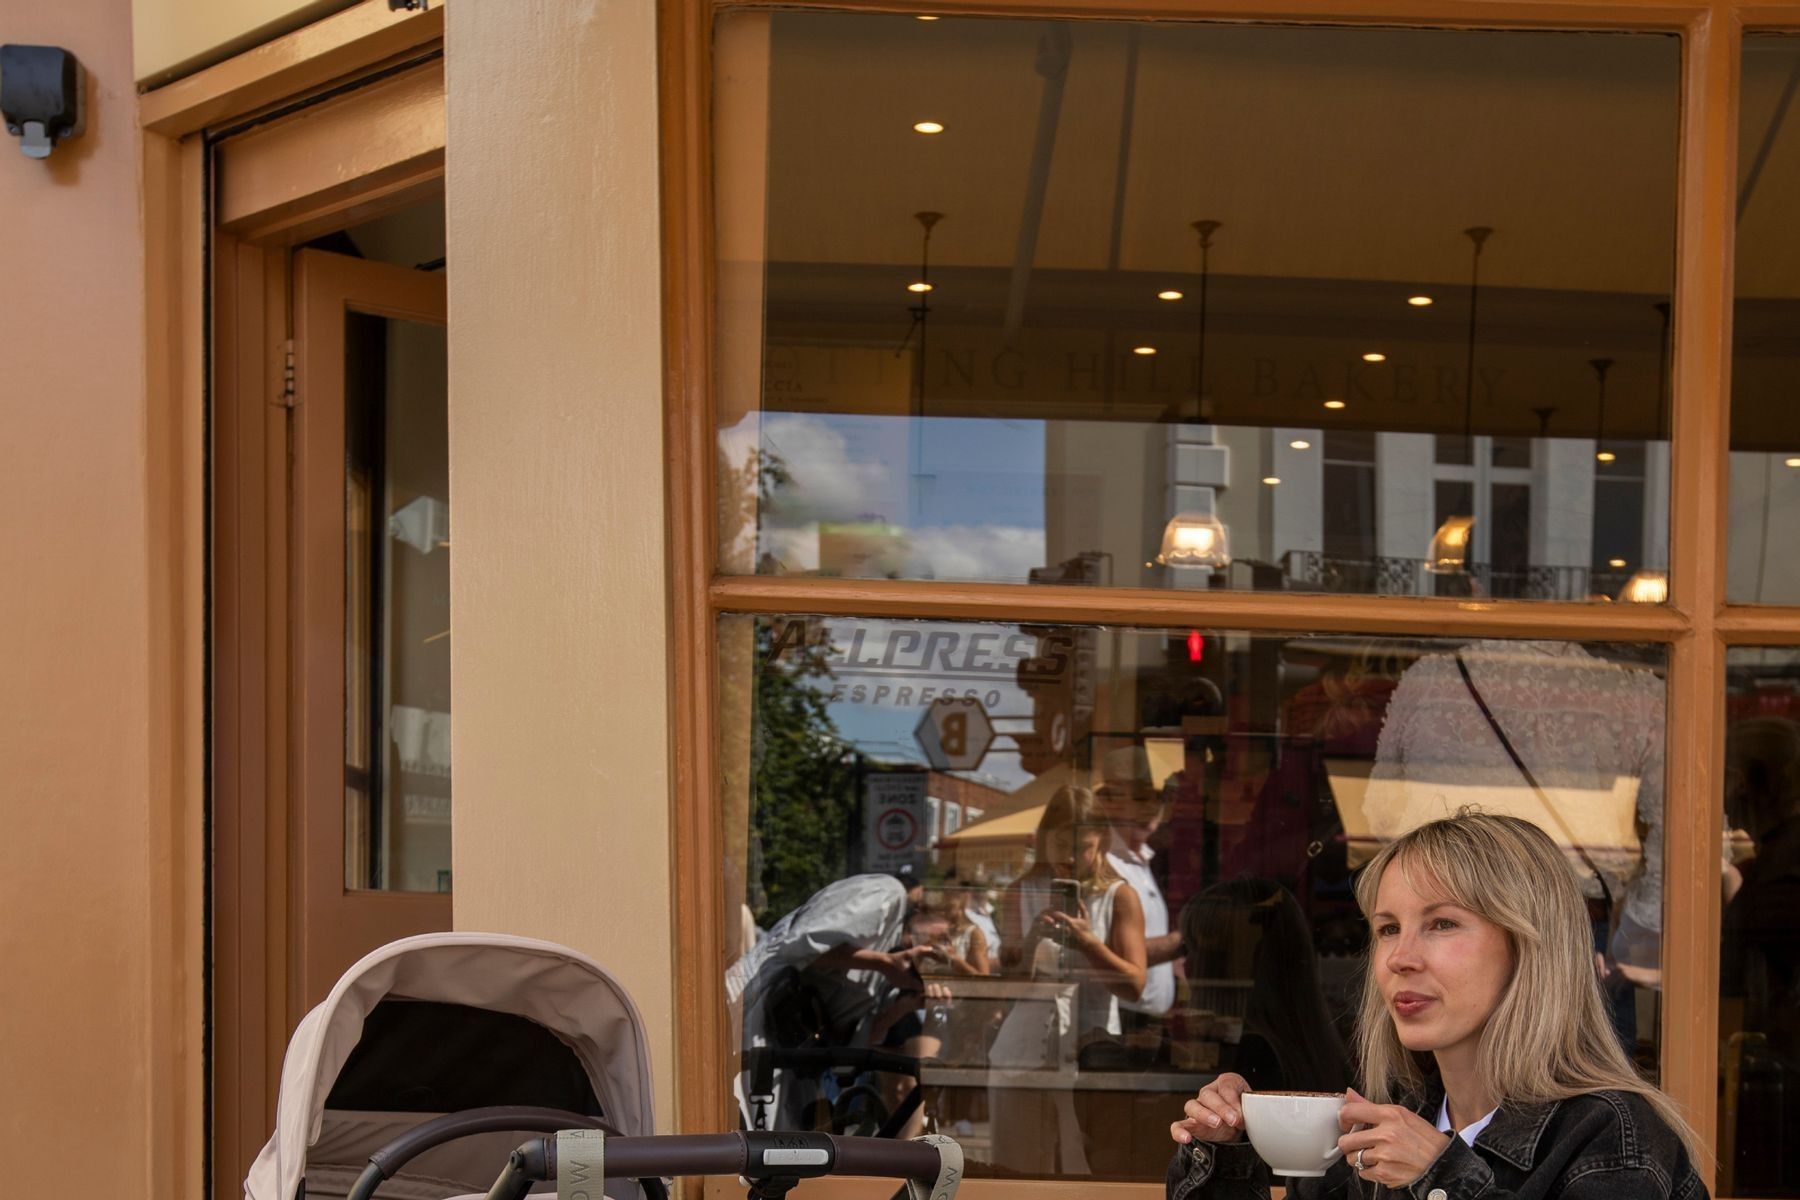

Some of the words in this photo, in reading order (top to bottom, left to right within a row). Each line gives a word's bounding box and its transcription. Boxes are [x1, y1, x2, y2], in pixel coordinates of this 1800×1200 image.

[1252, 357, 1509, 406] BAKERY
[766, 619, 1074, 676] ALLPRESS
[830, 683, 1003, 708] ESPRESSO
